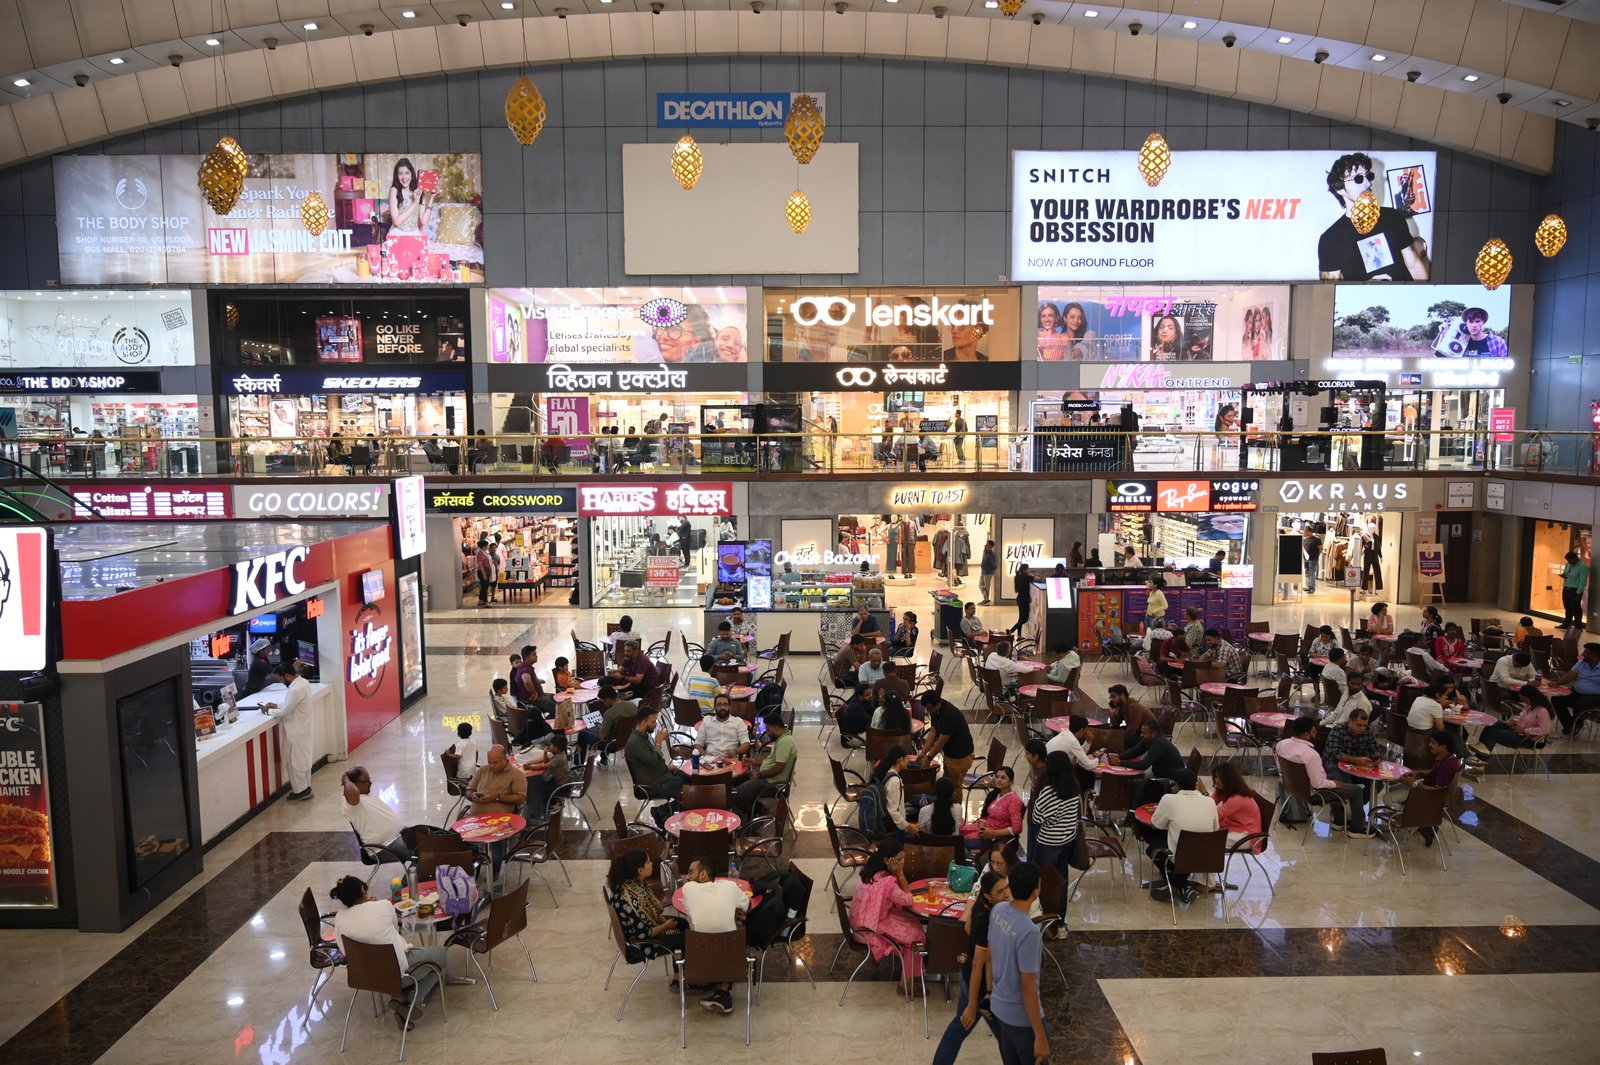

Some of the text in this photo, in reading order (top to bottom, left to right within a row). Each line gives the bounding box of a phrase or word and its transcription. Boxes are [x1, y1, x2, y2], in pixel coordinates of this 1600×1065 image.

[663, 100, 783, 121] DECATHLON
[1029, 168, 1110, 183] SNITCH
[240, 186, 284, 203] Spark
[1030, 198, 1301, 220] YOUR WARDROBE'S NEXT
[77, 216, 189, 230] THE BODY SHOP
[75, 236, 97, 245] SHOP
[152, 236, 164, 245] UG
[1030, 222, 1154, 243] OBSESSION
[209, 229, 353, 253] NEW JASMINE EDIT
[84, 246, 101, 254] SGS
[103, 246, 128, 255] MALL,
[1028, 258, 1155, 268] NOW AT GROUND FLOOR
[865, 296, 994, 326] lenskart
[1104, 296, 1178, 317] नायका
[376, 324, 420, 334] GO LIKE
[376, 335, 414, 344] NEVER
[1103, 334, 1133, 346] SPRITZ
[377, 344, 424, 354] BEFORE.
[549, 343, 631, 355] global specialists
[23, 377, 48, 388] THE
[52, 377, 87, 389] BODY
[89, 376, 125, 389] SHOP
[546, 364, 613, 391] व्हिजन
[882, 364, 949, 385] लेन्सकार्ट
[1101, 364, 1171, 388] NYKAA
[1187, 379, 1231, 388] TREND
[232, 373, 282, 393] स्केचर्स
[322, 377, 422, 389] SKECHERS
[551, 398, 577, 410] FLAT
[551, 411, 578, 439] 50
[1213, 481, 1259, 493] vogue
[1309, 483, 1408, 500] KRAUS
[93, 493, 128, 503] Cotton
[249, 486, 383, 512] GO COLORS!
[433, 491, 475, 507] क्रॉसवर्ड
[483, 494, 563, 507] CROSSWORD
[894, 489, 966, 506] BURNT TOAST
[1159, 483, 1208, 509] Ray-Ban
[1329, 502, 1384, 511] JEANS
[824, 550, 881, 566] Bazaar
[1006, 543, 1044, 560] BURNT
[234, 546, 305, 616] KFC
[260, 620, 276, 628] pepsi
